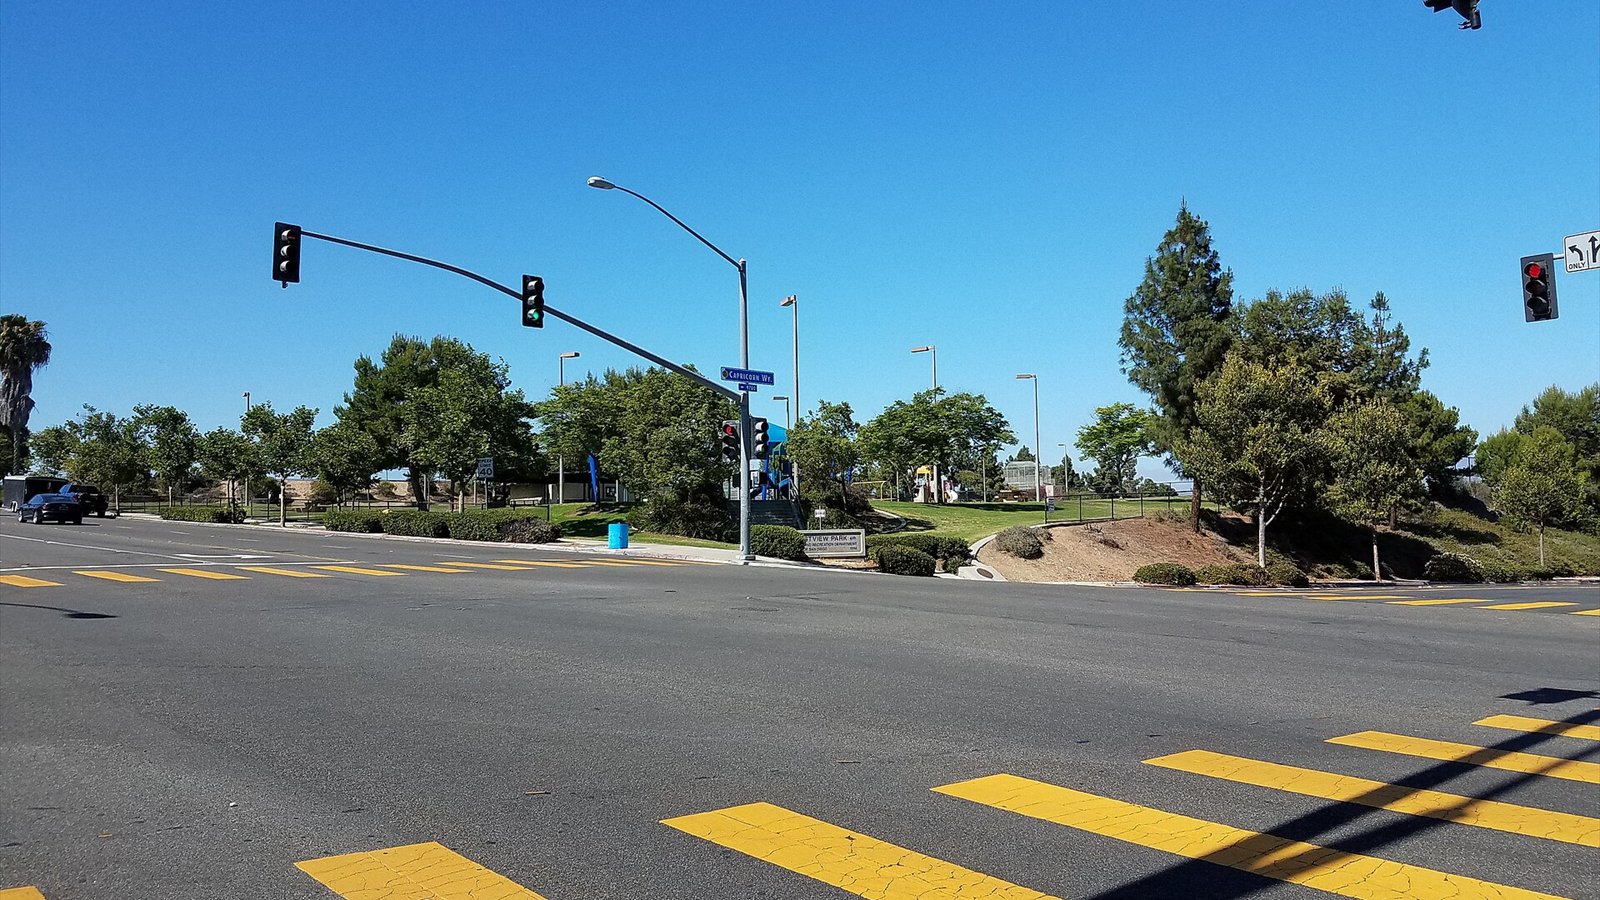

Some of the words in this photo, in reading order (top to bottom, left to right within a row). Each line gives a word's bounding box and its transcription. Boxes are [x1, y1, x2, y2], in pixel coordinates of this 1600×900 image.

[1568, 261, 1586, 270] ONLY
[729, 371, 760, 381] CAPRICORN
[480, 468, 492, 476] 40
